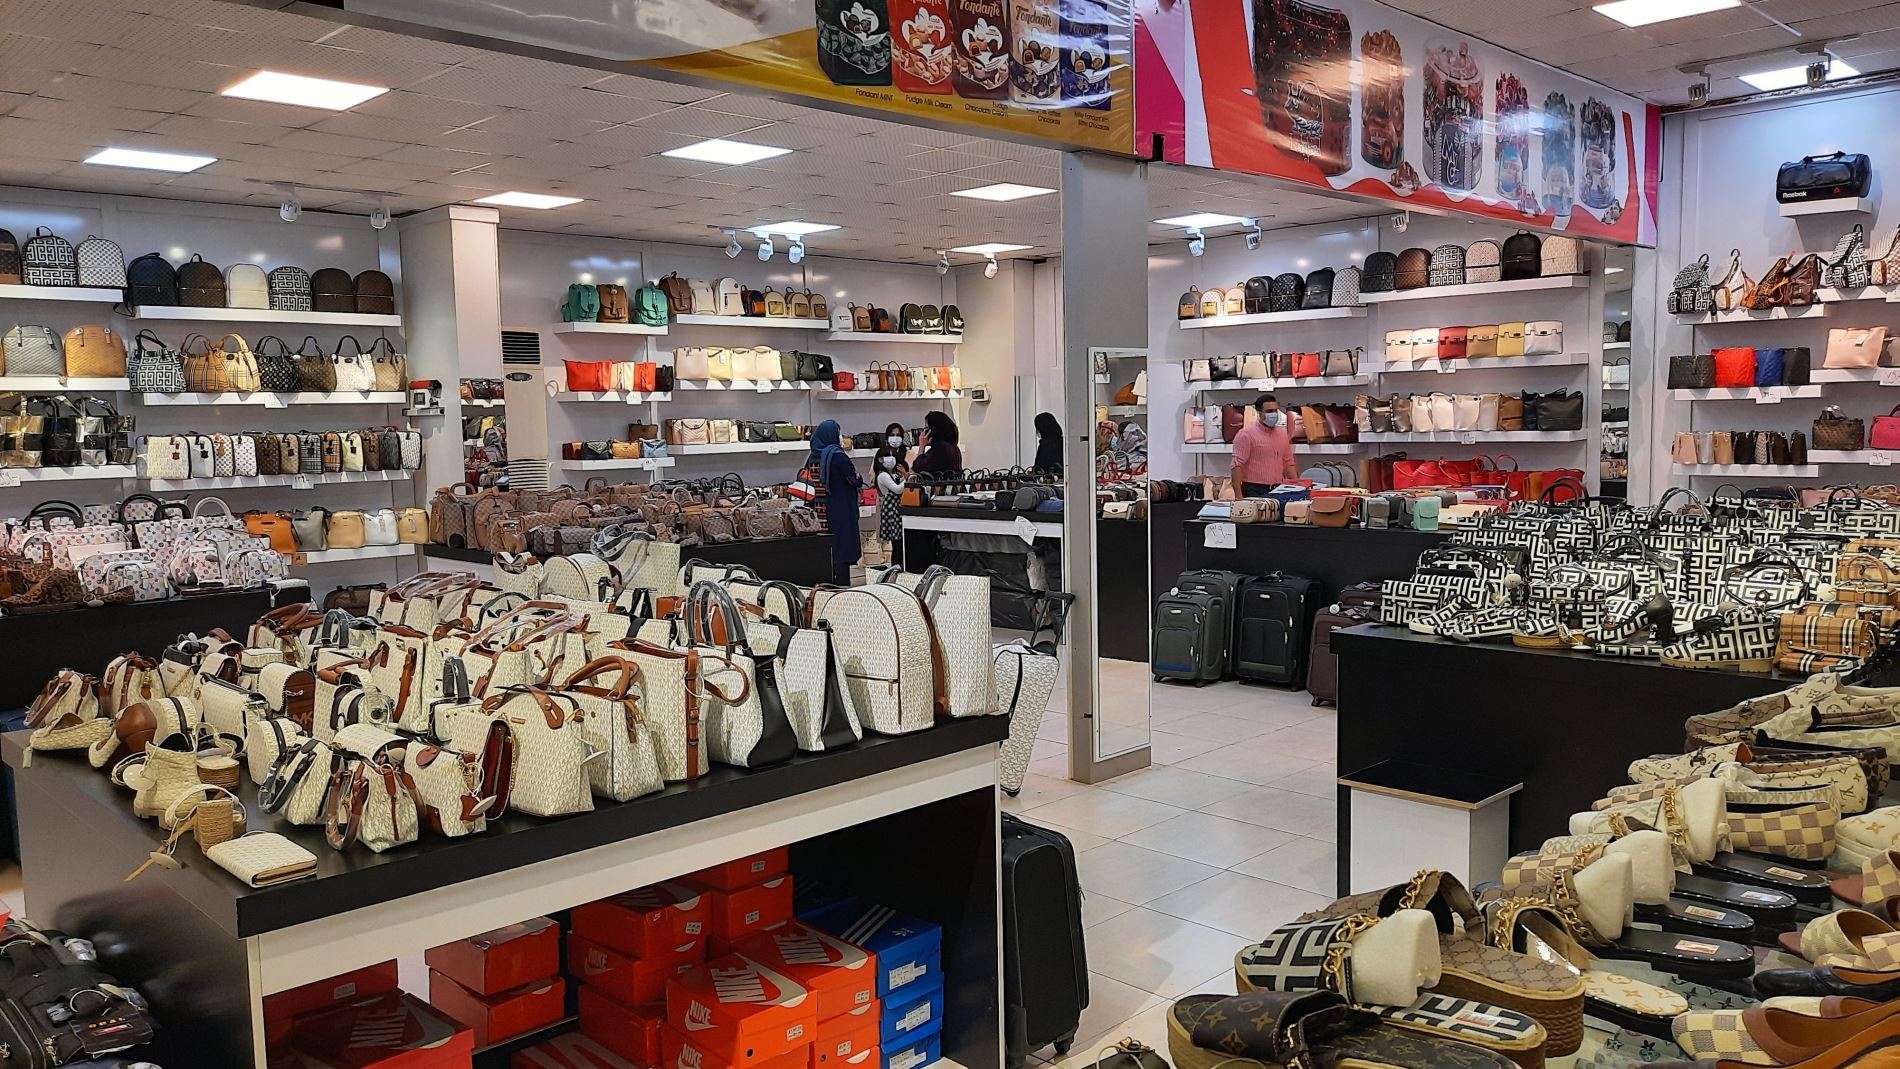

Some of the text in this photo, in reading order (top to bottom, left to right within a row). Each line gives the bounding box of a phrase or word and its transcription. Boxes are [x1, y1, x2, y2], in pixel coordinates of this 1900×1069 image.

[1015, 5, 1052, 27] Fondante
[1782, 191, 1807, 199] Reebok
[588, 947, 608, 969] NIKE
[710, 966, 768, 1004] NIKE
[689, 999, 712, 1025] NIKE
[682, 1043, 702, 1067] NIKE
